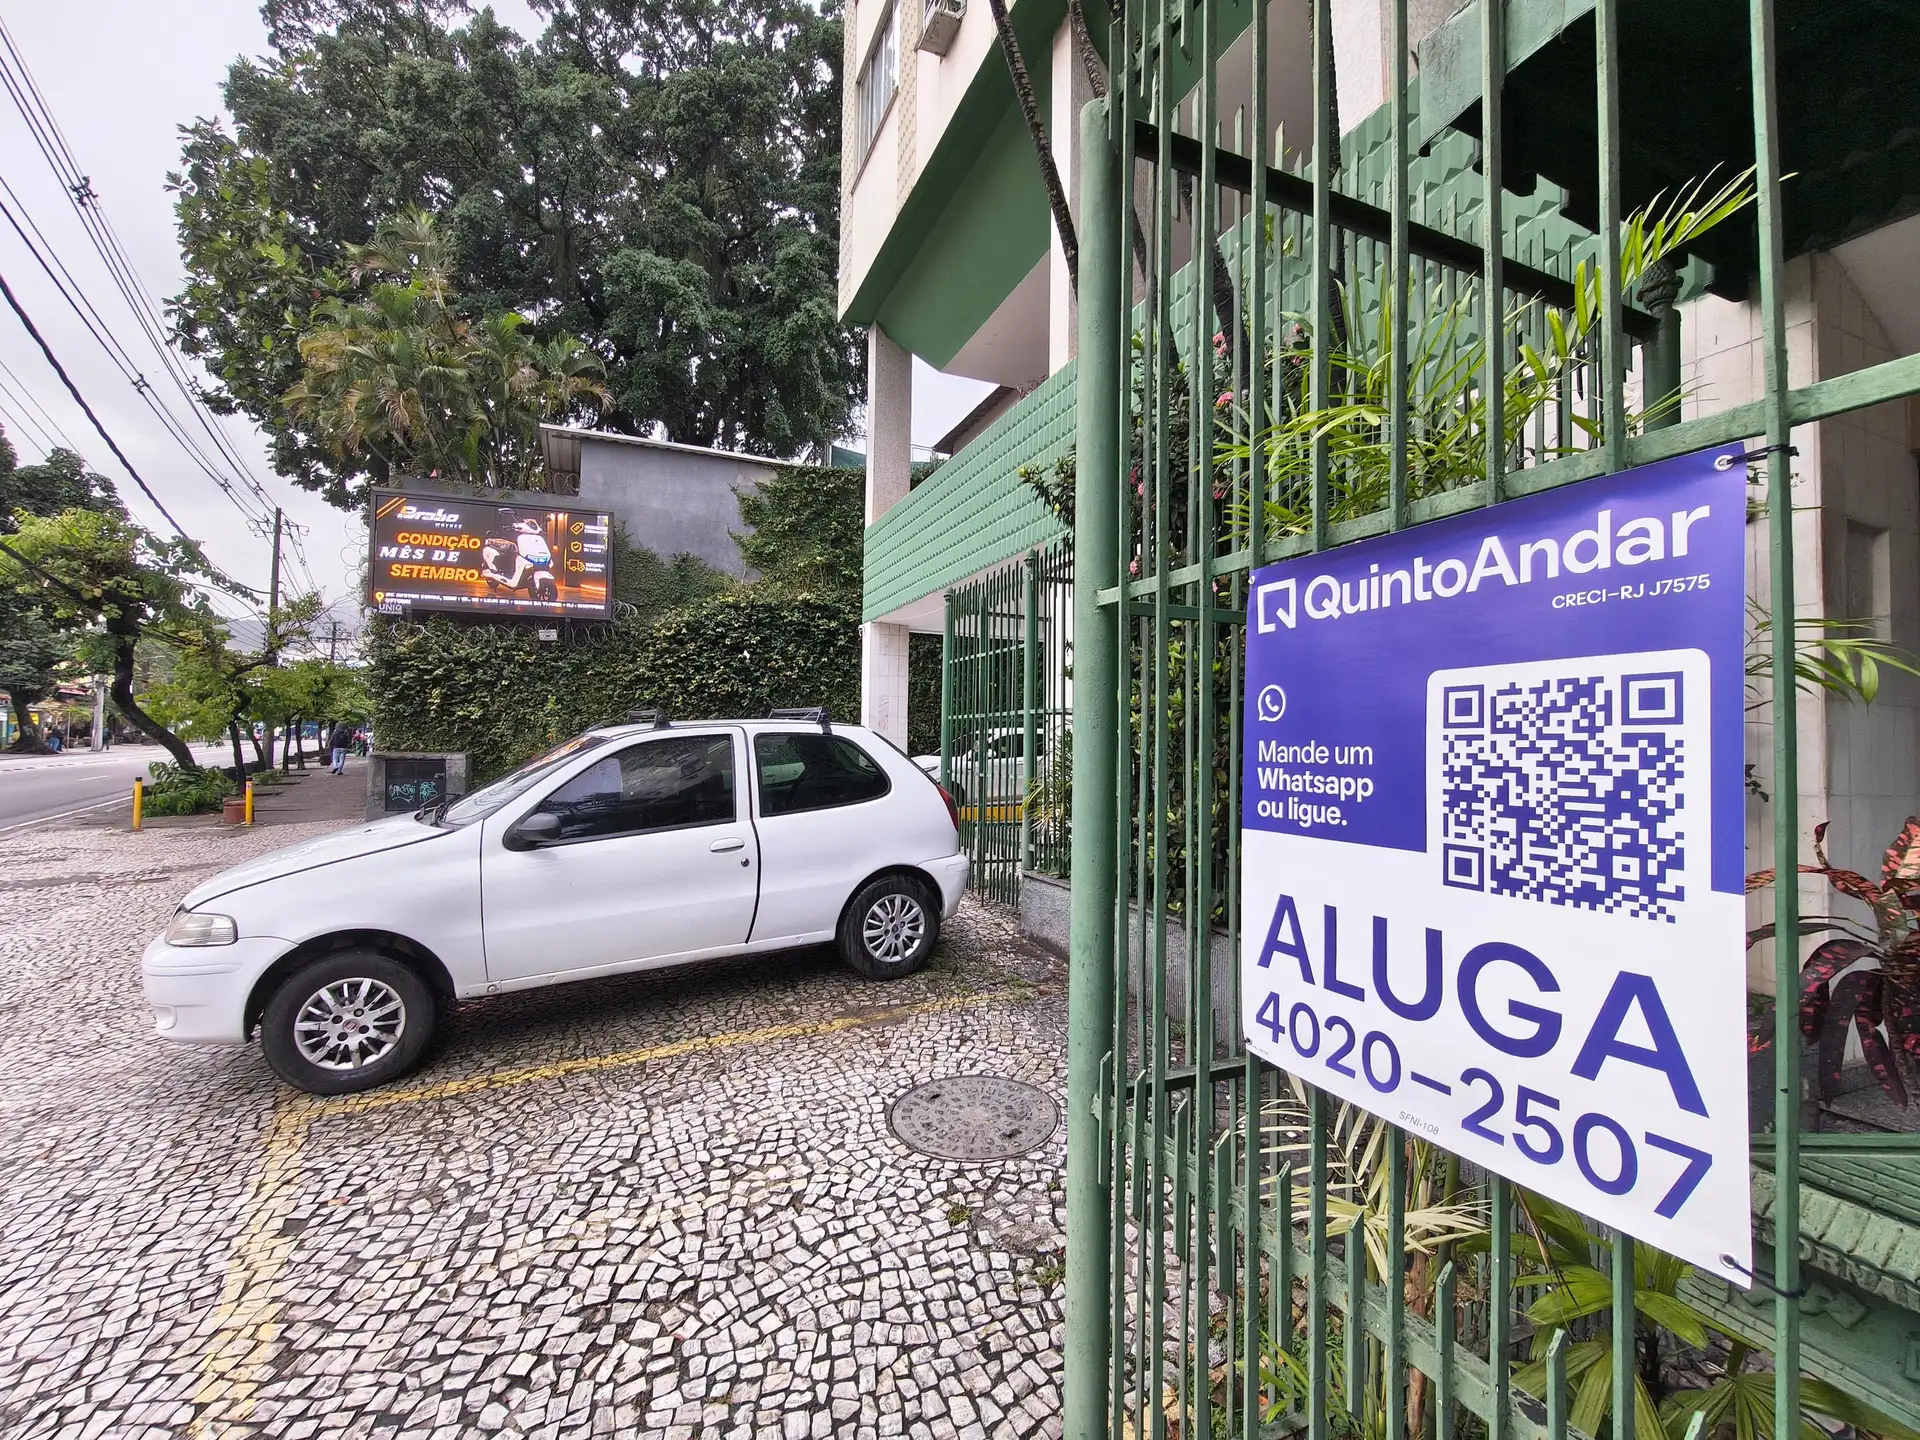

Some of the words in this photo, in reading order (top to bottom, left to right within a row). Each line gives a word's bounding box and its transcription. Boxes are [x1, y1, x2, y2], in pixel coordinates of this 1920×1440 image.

[397, 505, 460, 523] Brabo
[379, 545, 426, 560] MÊS
[432, 549, 460, 562] DE
[397, 532, 481, 551] CONDIÇÃO
[390, 563, 479, 581] SETEMBRO
[1303, 505, 1711, 620] QuintoAndar
[1648, 573, 1711, 596] J7575
[1257, 740, 1331, 765] Mande
[1334, 745, 1373, 765] um
[1257, 768, 1374, 802] Whatsapp
[1257, 801, 1285, 819] ou
[1287, 797, 1348, 828] ligue.
[1257, 893, 1710, 1119] ALUGA
[1255, 991, 1713, 1220] 4020-2507
[1399, 1110, 1440, 1135] SFNI-108
